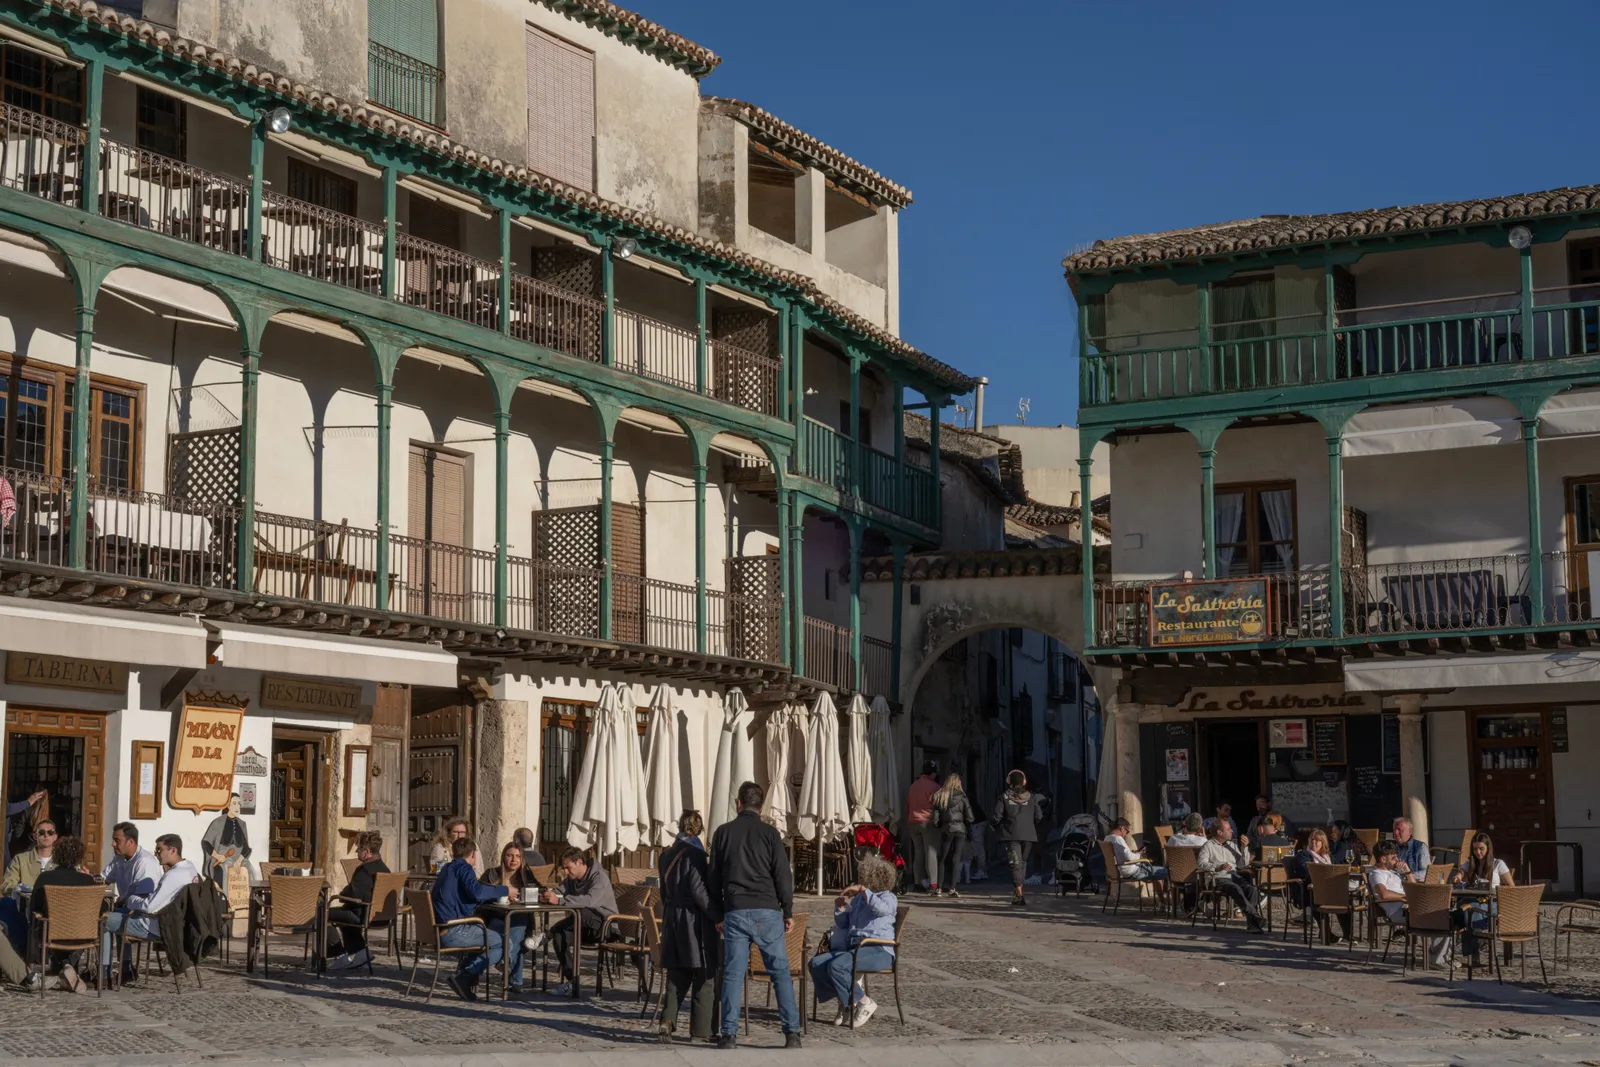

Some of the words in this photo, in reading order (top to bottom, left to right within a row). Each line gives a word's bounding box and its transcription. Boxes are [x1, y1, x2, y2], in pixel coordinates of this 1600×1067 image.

[1154, 592, 1177, 608] La
[1177, 594, 1264, 614] Sastrería
[1158, 619, 1239, 631] Restaurante
[24, 657, 113, 685] TABERNA
[267, 683, 358, 709] RESTAURANTE
[1179, 691, 1222, 713] La
[176, 770, 233, 790] VIRREYNA
